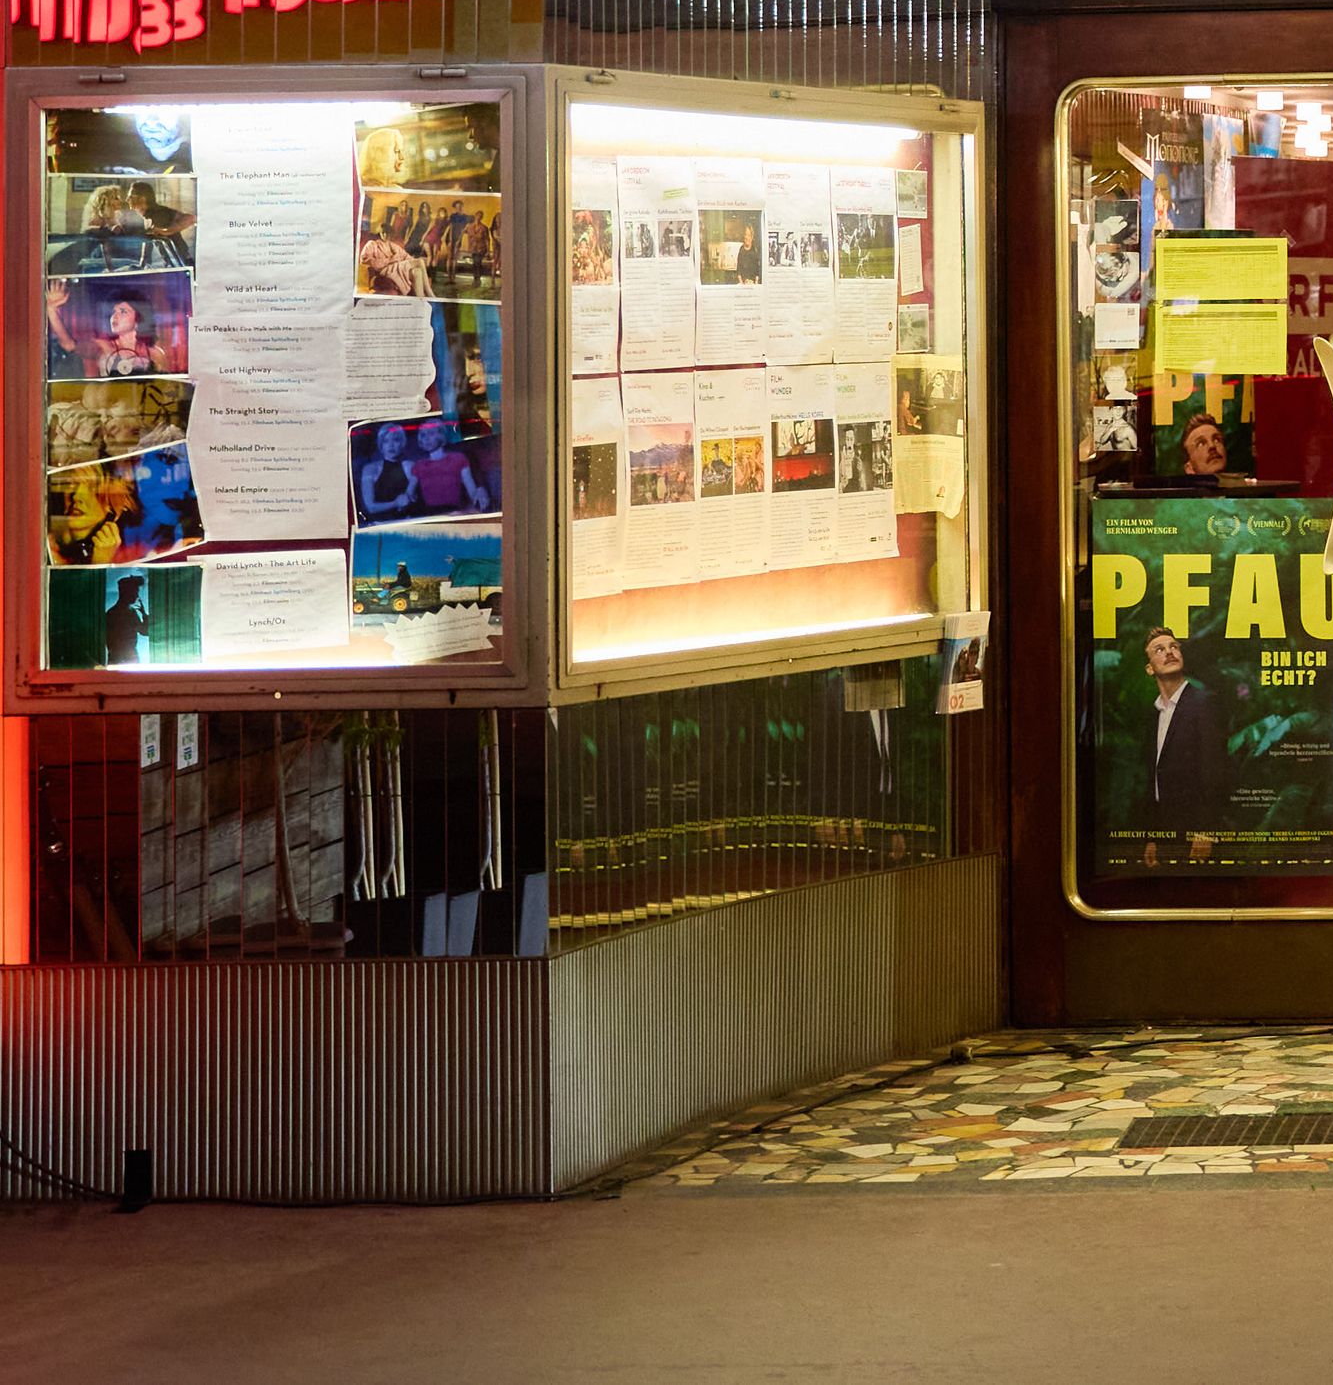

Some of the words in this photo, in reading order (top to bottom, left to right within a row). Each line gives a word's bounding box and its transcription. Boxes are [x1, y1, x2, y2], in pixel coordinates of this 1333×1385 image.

[220, 172, 235, 180] The
[236, 172, 271, 181] Elephant
[248, 220, 273, 228] Velvet
[225, 285, 244, 293] Wild
[255, 285, 278, 293] Heart
[213, 325, 238, 333] Peaks:
[238, 366, 272, 375] Highway
[208, 407, 224, 415] The
[225, 407, 256, 416] Straight
[258, 407, 279, 416] Story
[209, 445, 253, 453] Mulholland
[254, 444, 276, 452] Drive
[215, 486, 239, 494] Inland
[240, 486, 268, 494] Empire
[1138, 518, 1154, 526] VON
[1253, 520, 1285, 529] VIENNALE
[1106, 527, 1146, 535] BERNHARD
[1146, 527, 1178, 535] WENGER
[216, 562, 238, 570] David
[240, 561, 263, 570] Lynch
[1261, 651, 1292, 667] BIN
[1297, 651, 1327, 667] ICH
[1261, 670, 1317, 686] ECHT?
[949, 694, 964, 710] 02
[1109, 830, 1146, 839] ALBRECHT
[1147, 831, 1177, 839] SCHUCH
